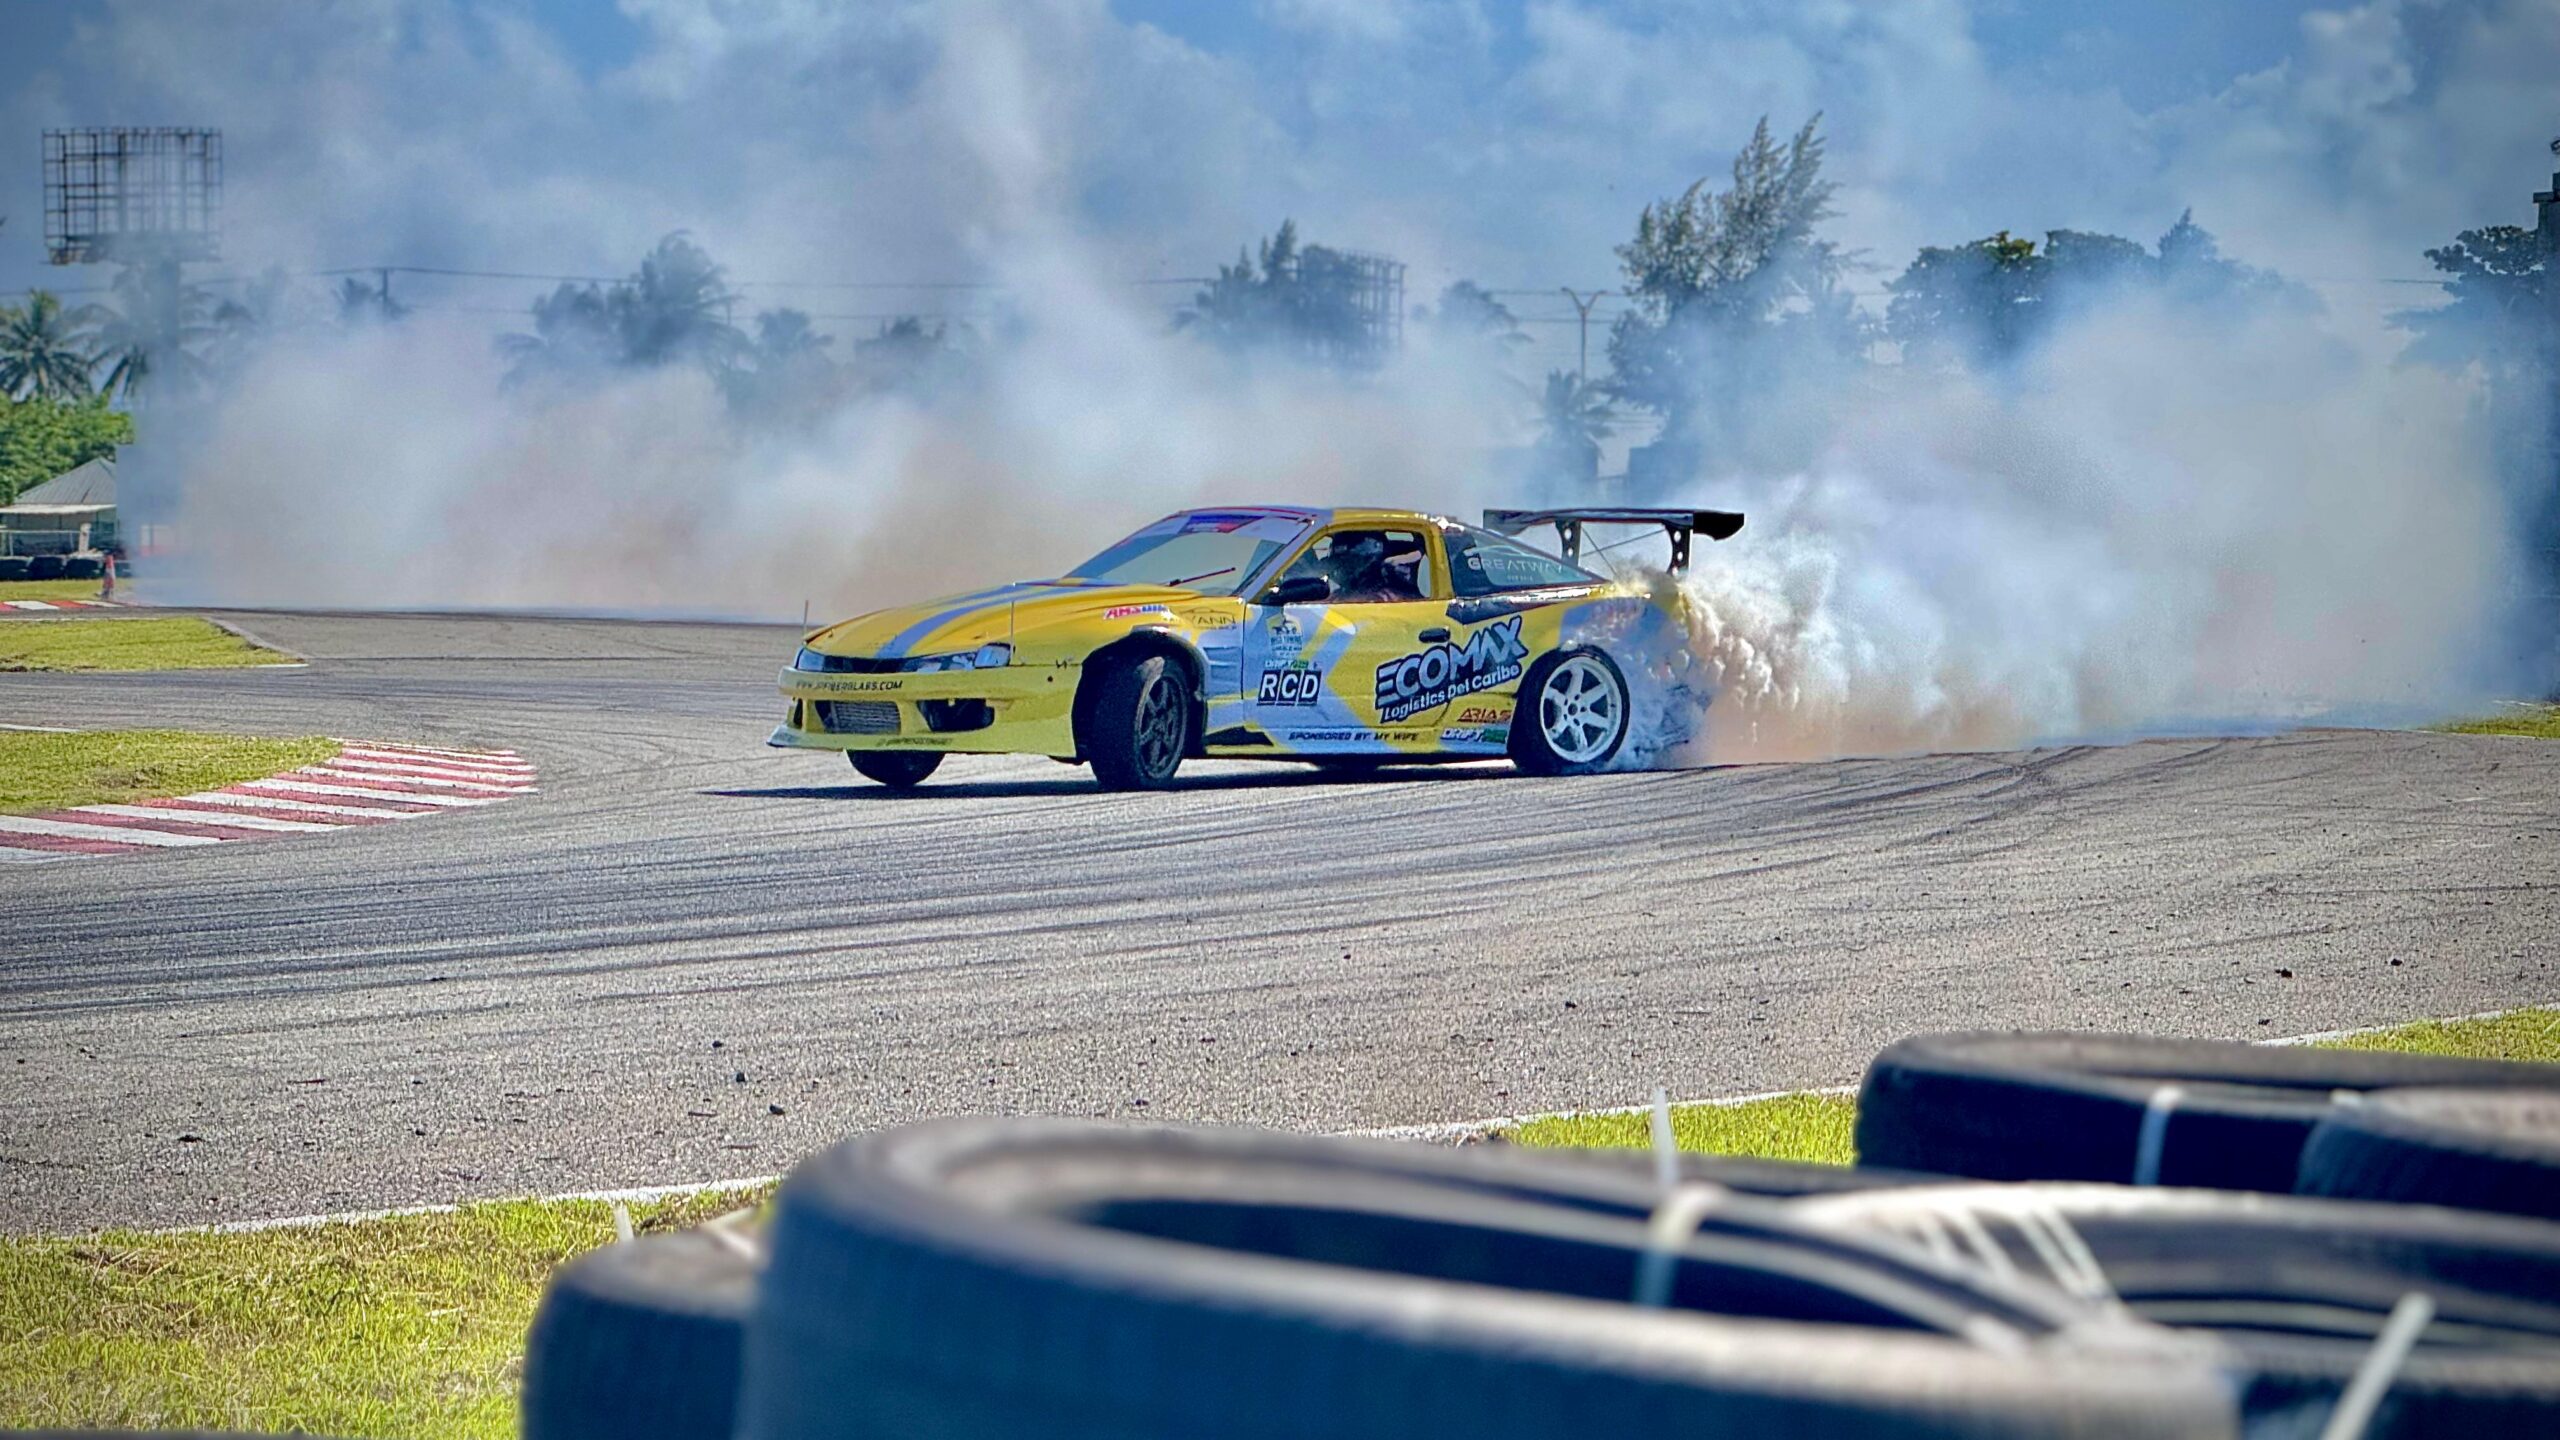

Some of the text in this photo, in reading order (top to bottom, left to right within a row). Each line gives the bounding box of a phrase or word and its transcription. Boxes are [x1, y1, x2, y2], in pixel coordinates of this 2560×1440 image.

[1467, 557, 1562, 574] GREATWAY
[1377, 616, 1528, 706] ECOMAX
[1260, 673, 1319, 699] RCD
[1384, 664, 1520, 720] Logistics Del Caribe
[1288, 731, 1352, 741] SPONSORED
[1374, 731, 1389, 741] MY
[1393, 731, 1420, 741] WIFE
